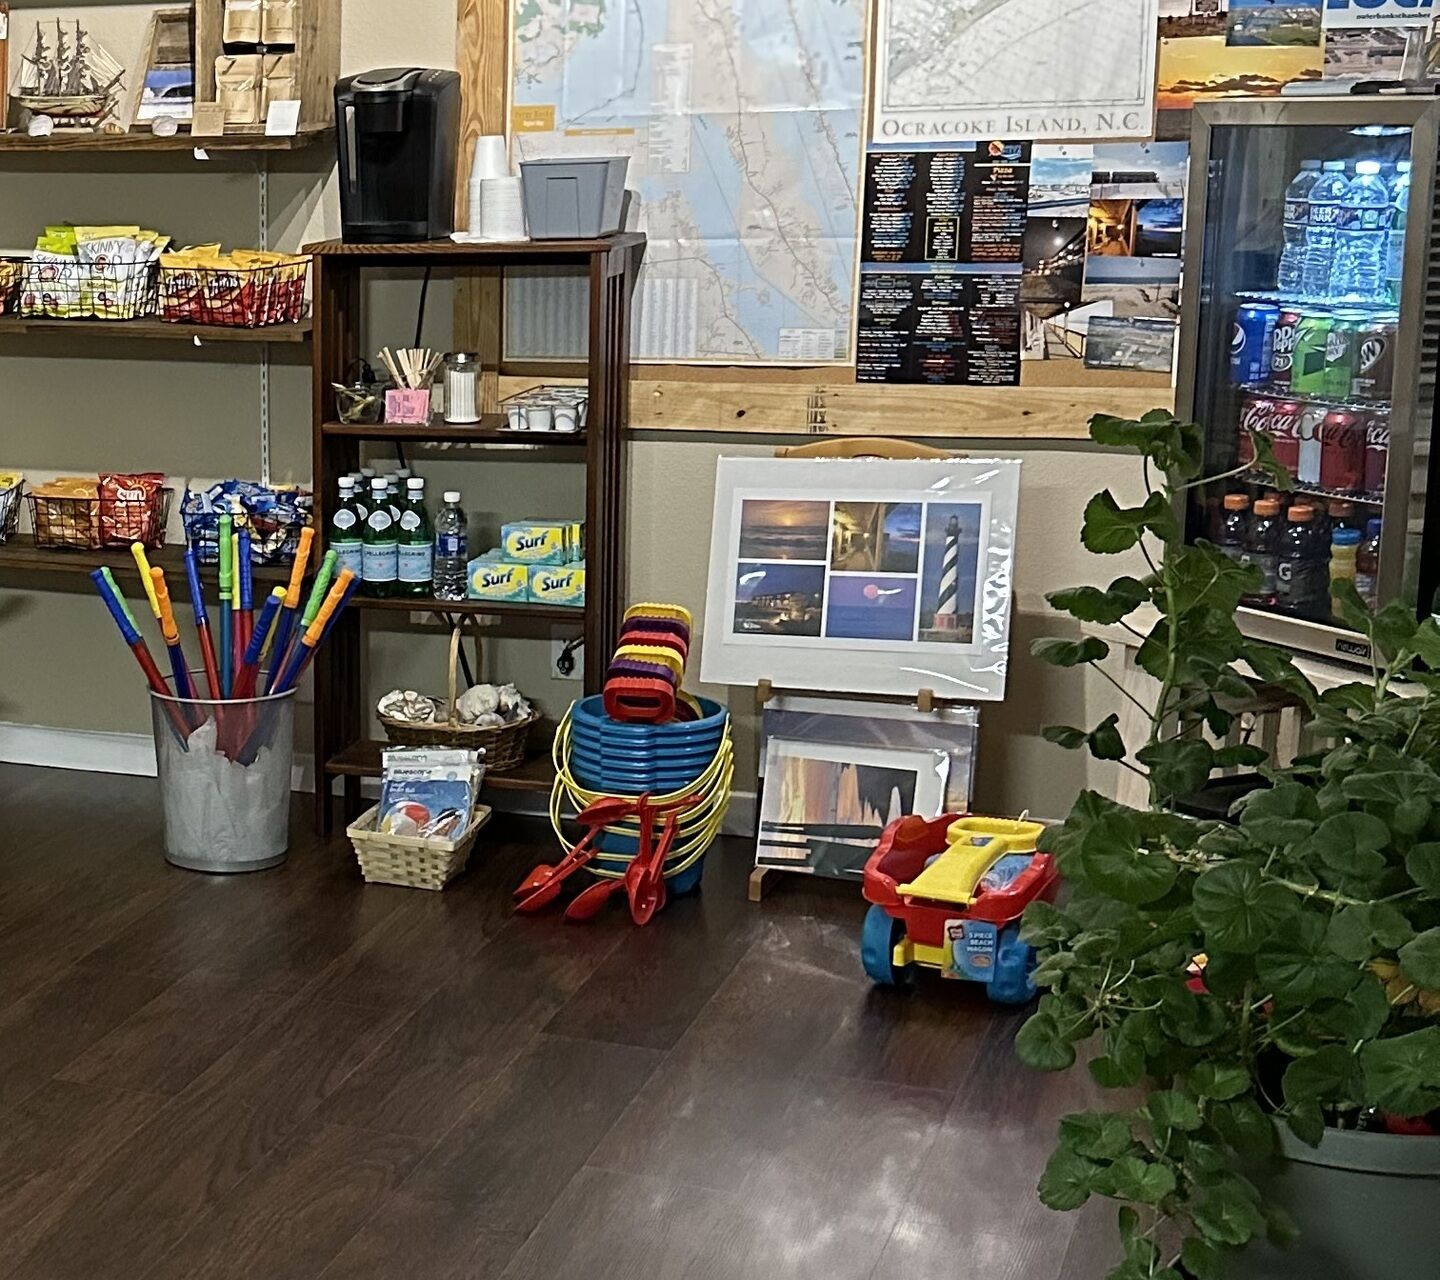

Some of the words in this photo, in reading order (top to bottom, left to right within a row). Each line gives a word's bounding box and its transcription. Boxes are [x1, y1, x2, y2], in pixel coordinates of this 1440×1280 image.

[1095, 111, 1145, 132] N.C.
[86, 240, 124, 254] SKINNY
[516, 530, 549, 552] Surf
[482, 568, 514, 588] Surf
[541, 572, 574, 592] Surf
